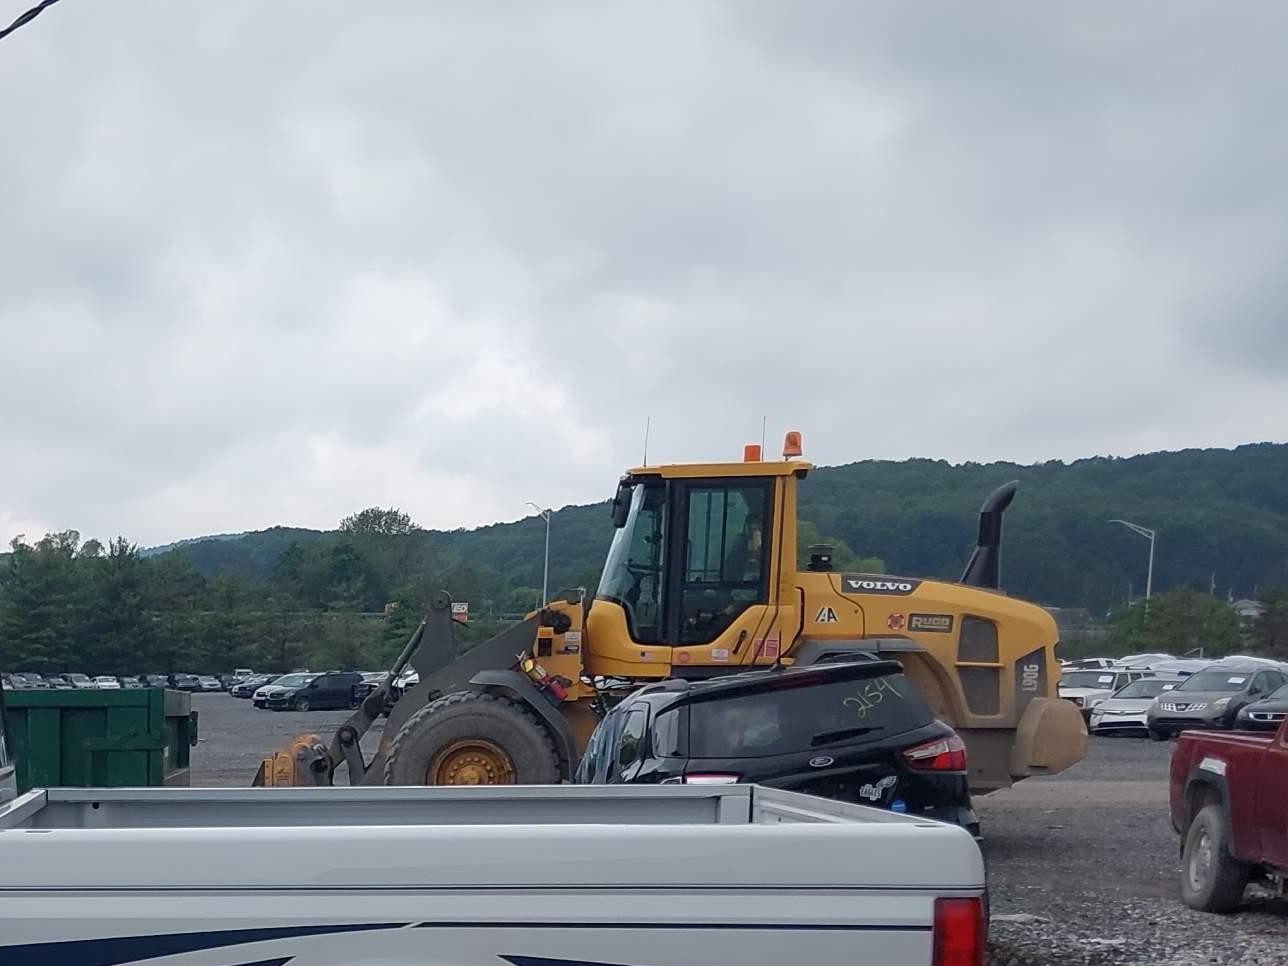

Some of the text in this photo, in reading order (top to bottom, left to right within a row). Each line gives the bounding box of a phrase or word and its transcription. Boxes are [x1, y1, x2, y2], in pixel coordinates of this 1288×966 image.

[847, 579, 912, 591] VOLVO
[1022, 664, 1039, 691] L90G
[843, 677, 903, 718] 2154
